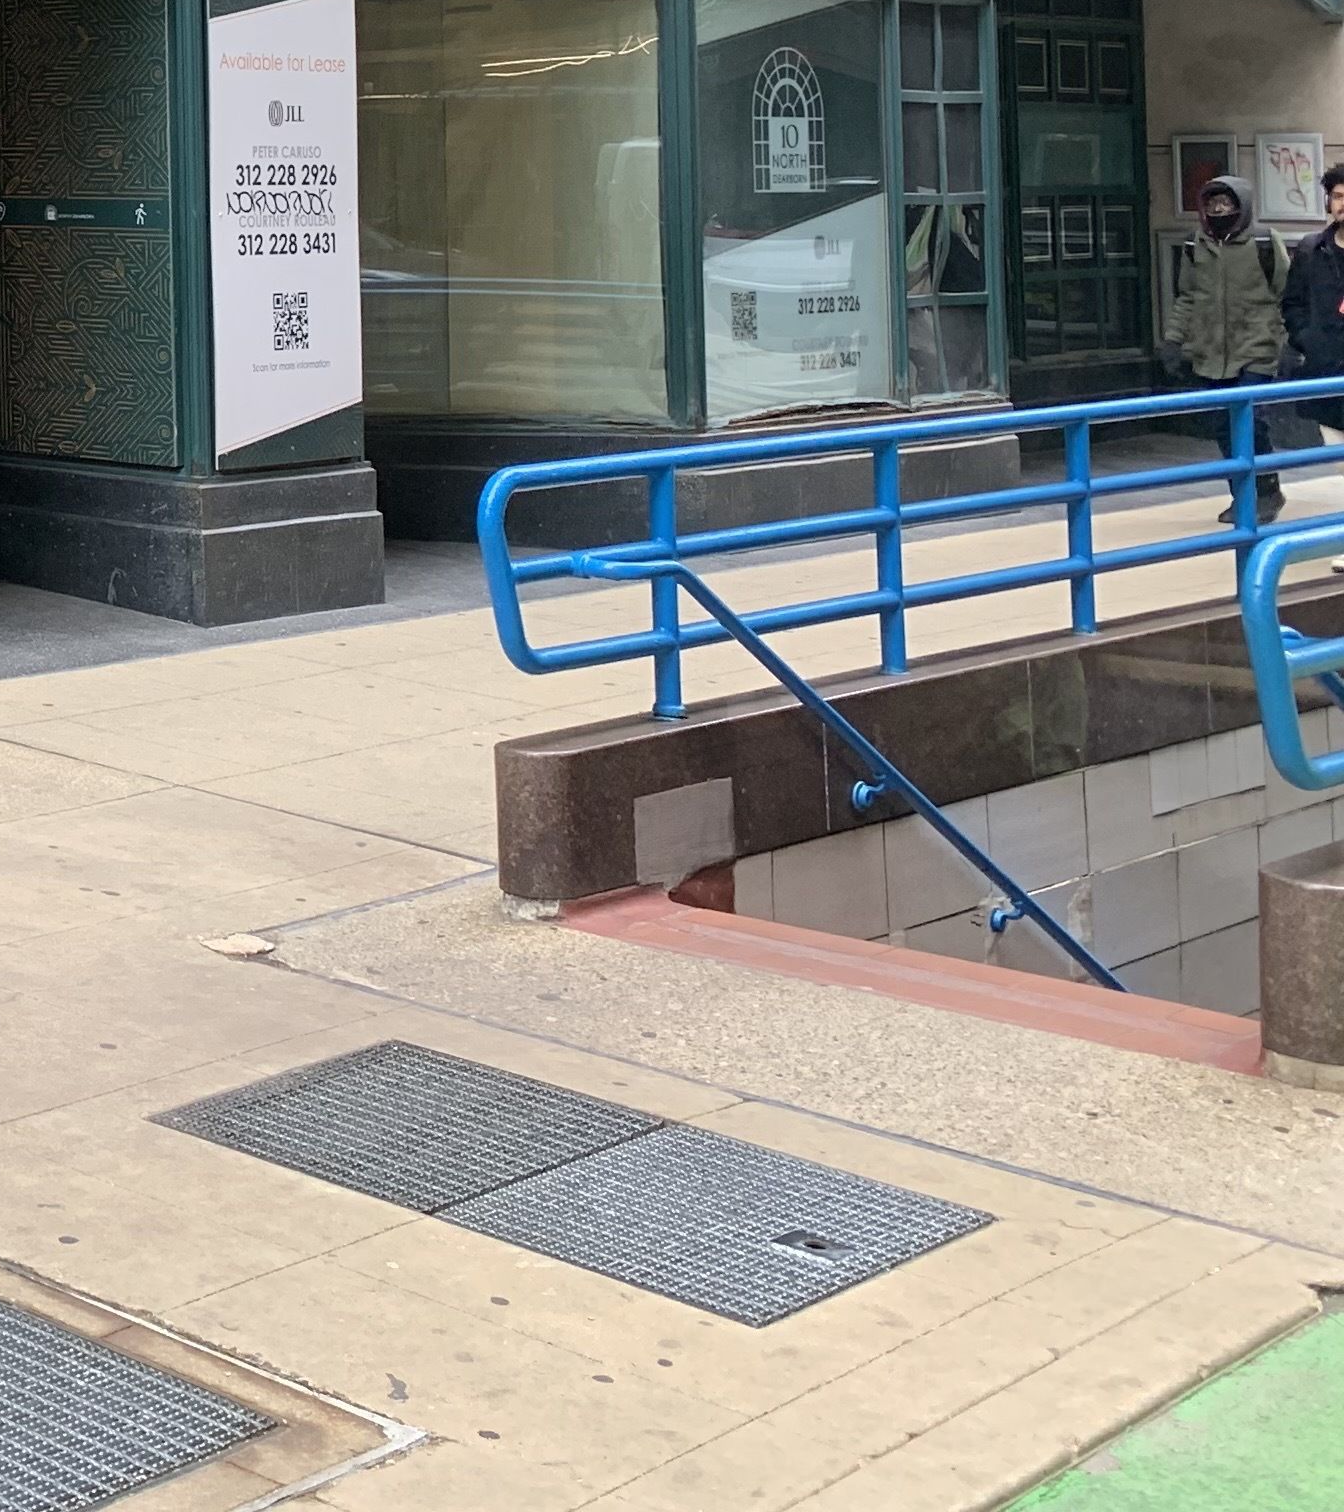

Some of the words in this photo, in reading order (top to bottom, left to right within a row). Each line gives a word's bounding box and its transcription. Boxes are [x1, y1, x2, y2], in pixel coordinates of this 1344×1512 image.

[220, 53, 283, 71] Available
[288, 54, 304, 71] for
[309, 55, 345, 73] Lease
[285, 105, 305, 122] JLL
[781, 124, 799, 149] 10
[252, 146, 278, 158] PETER
[281, 145, 322, 159] CARUSO
[772, 154, 807, 169] NORTH
[236, 164, 261, 186] 312
[267, 164, 296, 186] 228
[301, 164, 337, 186] 2926
[238, 214, 290, 228] COURTNEY
[238, 234, 263, 256] 312
[269, 233, 297, 255] 228
[303, 232, 336, 254] 3431
[798, 297, 814, 315] 312
[817, 297, 836, 314] 228
[838, 295, 860, 313] 2926
